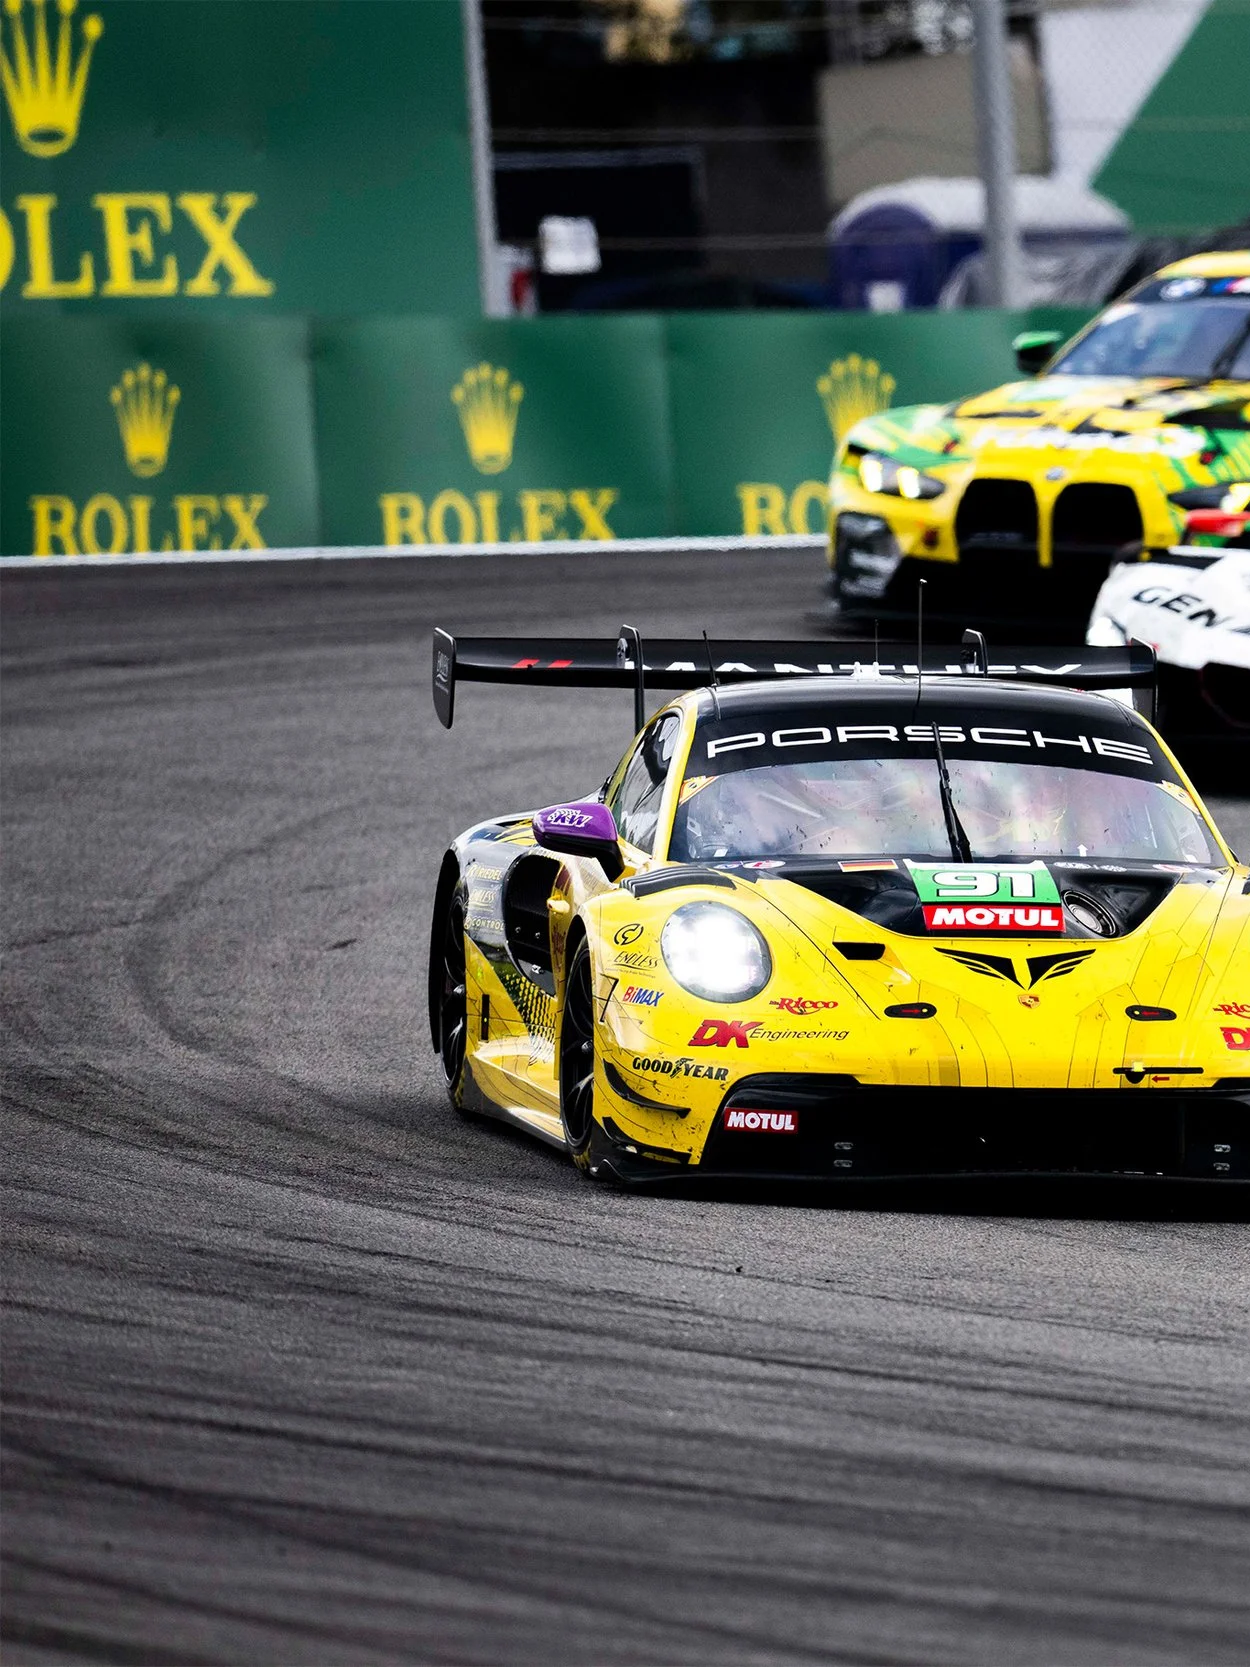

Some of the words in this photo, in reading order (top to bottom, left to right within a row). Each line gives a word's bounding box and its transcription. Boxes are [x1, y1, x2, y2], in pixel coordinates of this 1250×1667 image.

[0, 192, 275, 298] LEX
[28, 493, 269, 557] ROLEX
[380, 488, 621, 547] ROLEX
[1132, 586, 1235, 627] GEN
[706, 726, 1154, 765] PORSCHE
[552, 813, 593, 828] KW
[932, 871, 1035, 898] 91
[931, 907, 1060, 927] MOTUL
[613, 951, 660, 969] ENDLESS
[687, 1019, 765, 1048] DK
[750, 1028, 850, 1041] Engineering
[727, 1112, 795, 1130] MOTUL
